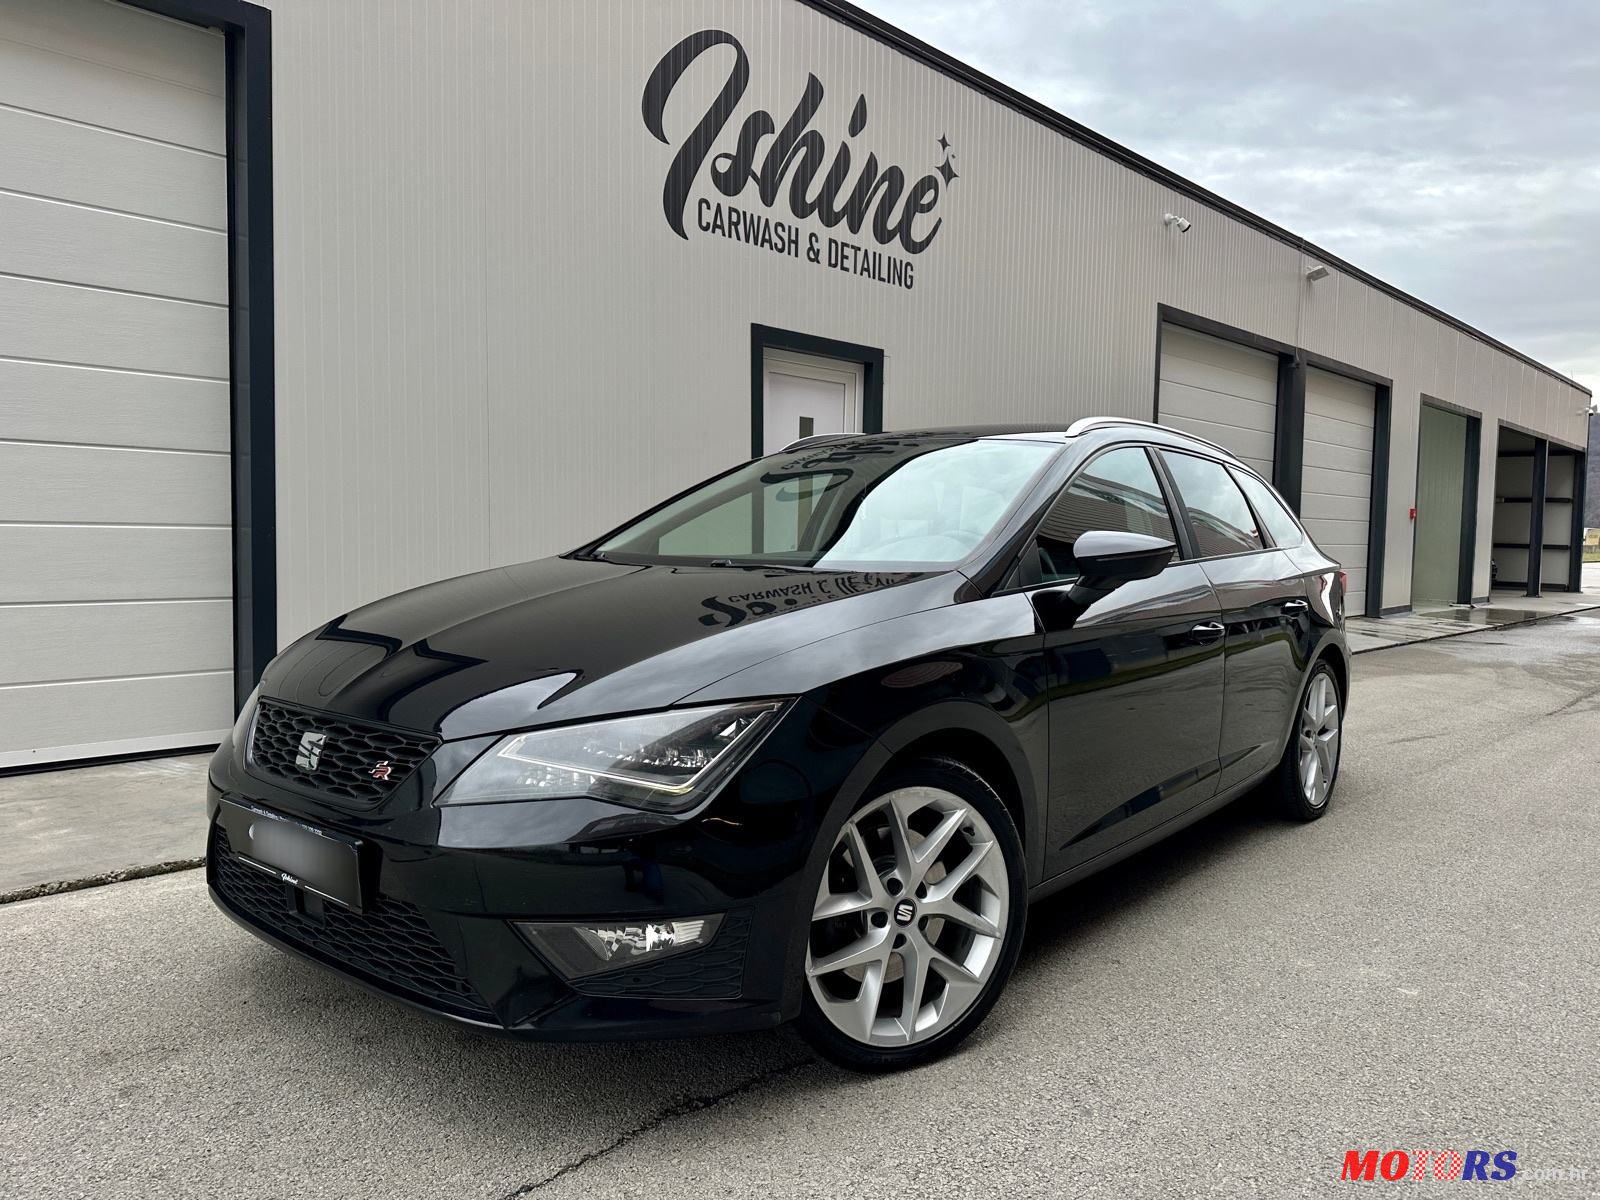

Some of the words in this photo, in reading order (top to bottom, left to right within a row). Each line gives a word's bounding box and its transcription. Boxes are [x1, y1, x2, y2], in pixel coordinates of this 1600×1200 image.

[641, 29, 943, 255] Ishine
[697, 198, 799, 258] CARWASH
[806, 232, 821, 265] &
[827, 238, 914, 290] DETAILING
